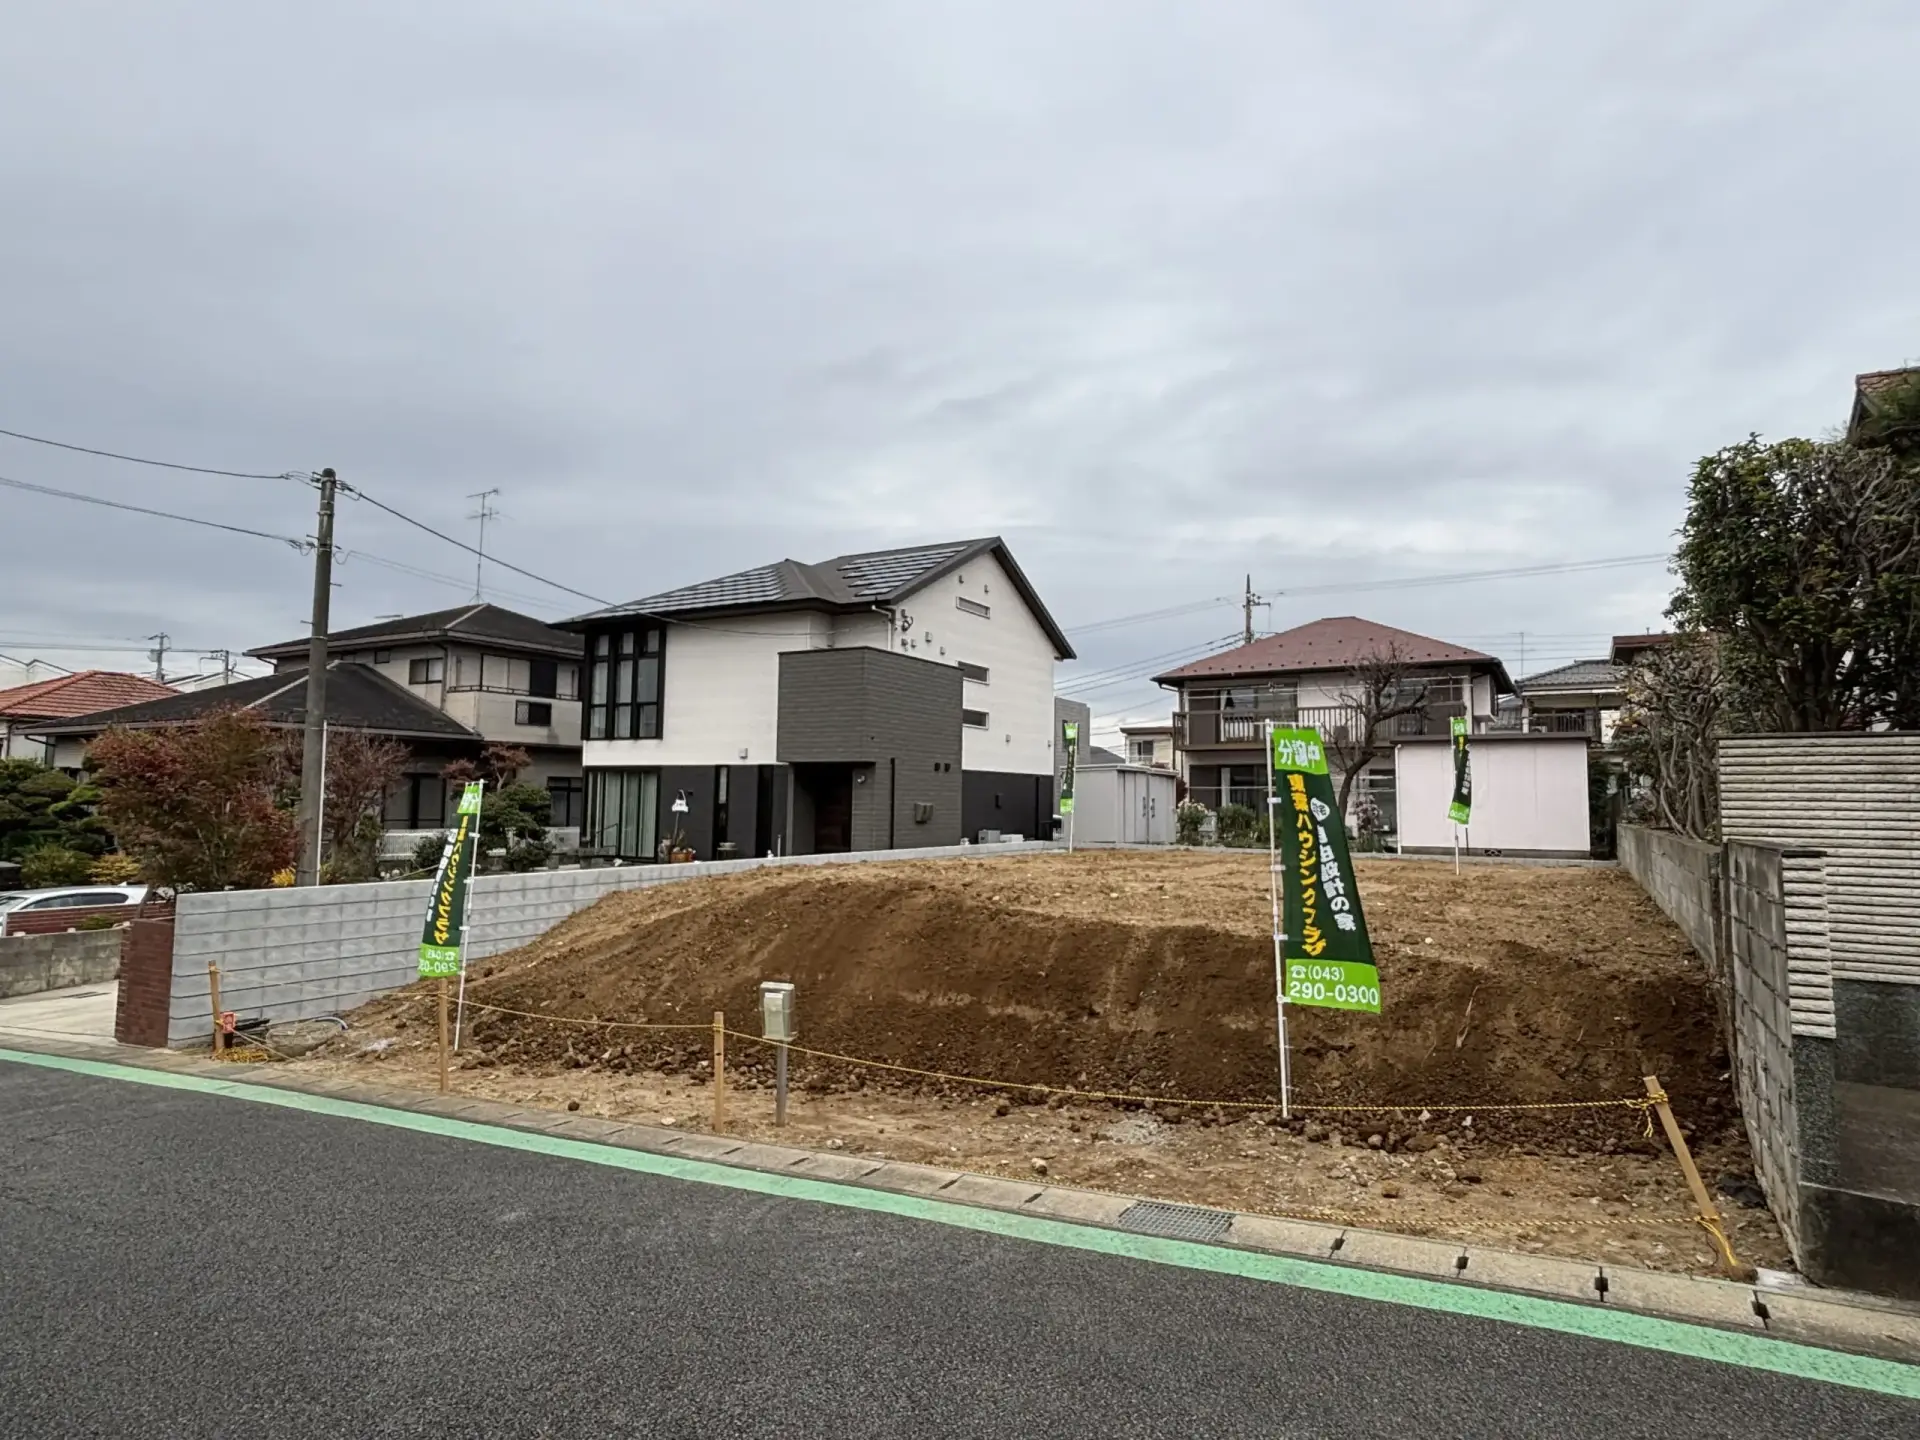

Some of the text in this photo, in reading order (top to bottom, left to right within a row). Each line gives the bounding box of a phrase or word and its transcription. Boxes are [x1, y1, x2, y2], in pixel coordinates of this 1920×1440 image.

[1278, 738, 1321, 769] 分譲中
[1308, 967, 1345, 981] (043)
[1289, 981, 1380, 1006] 290-0300
